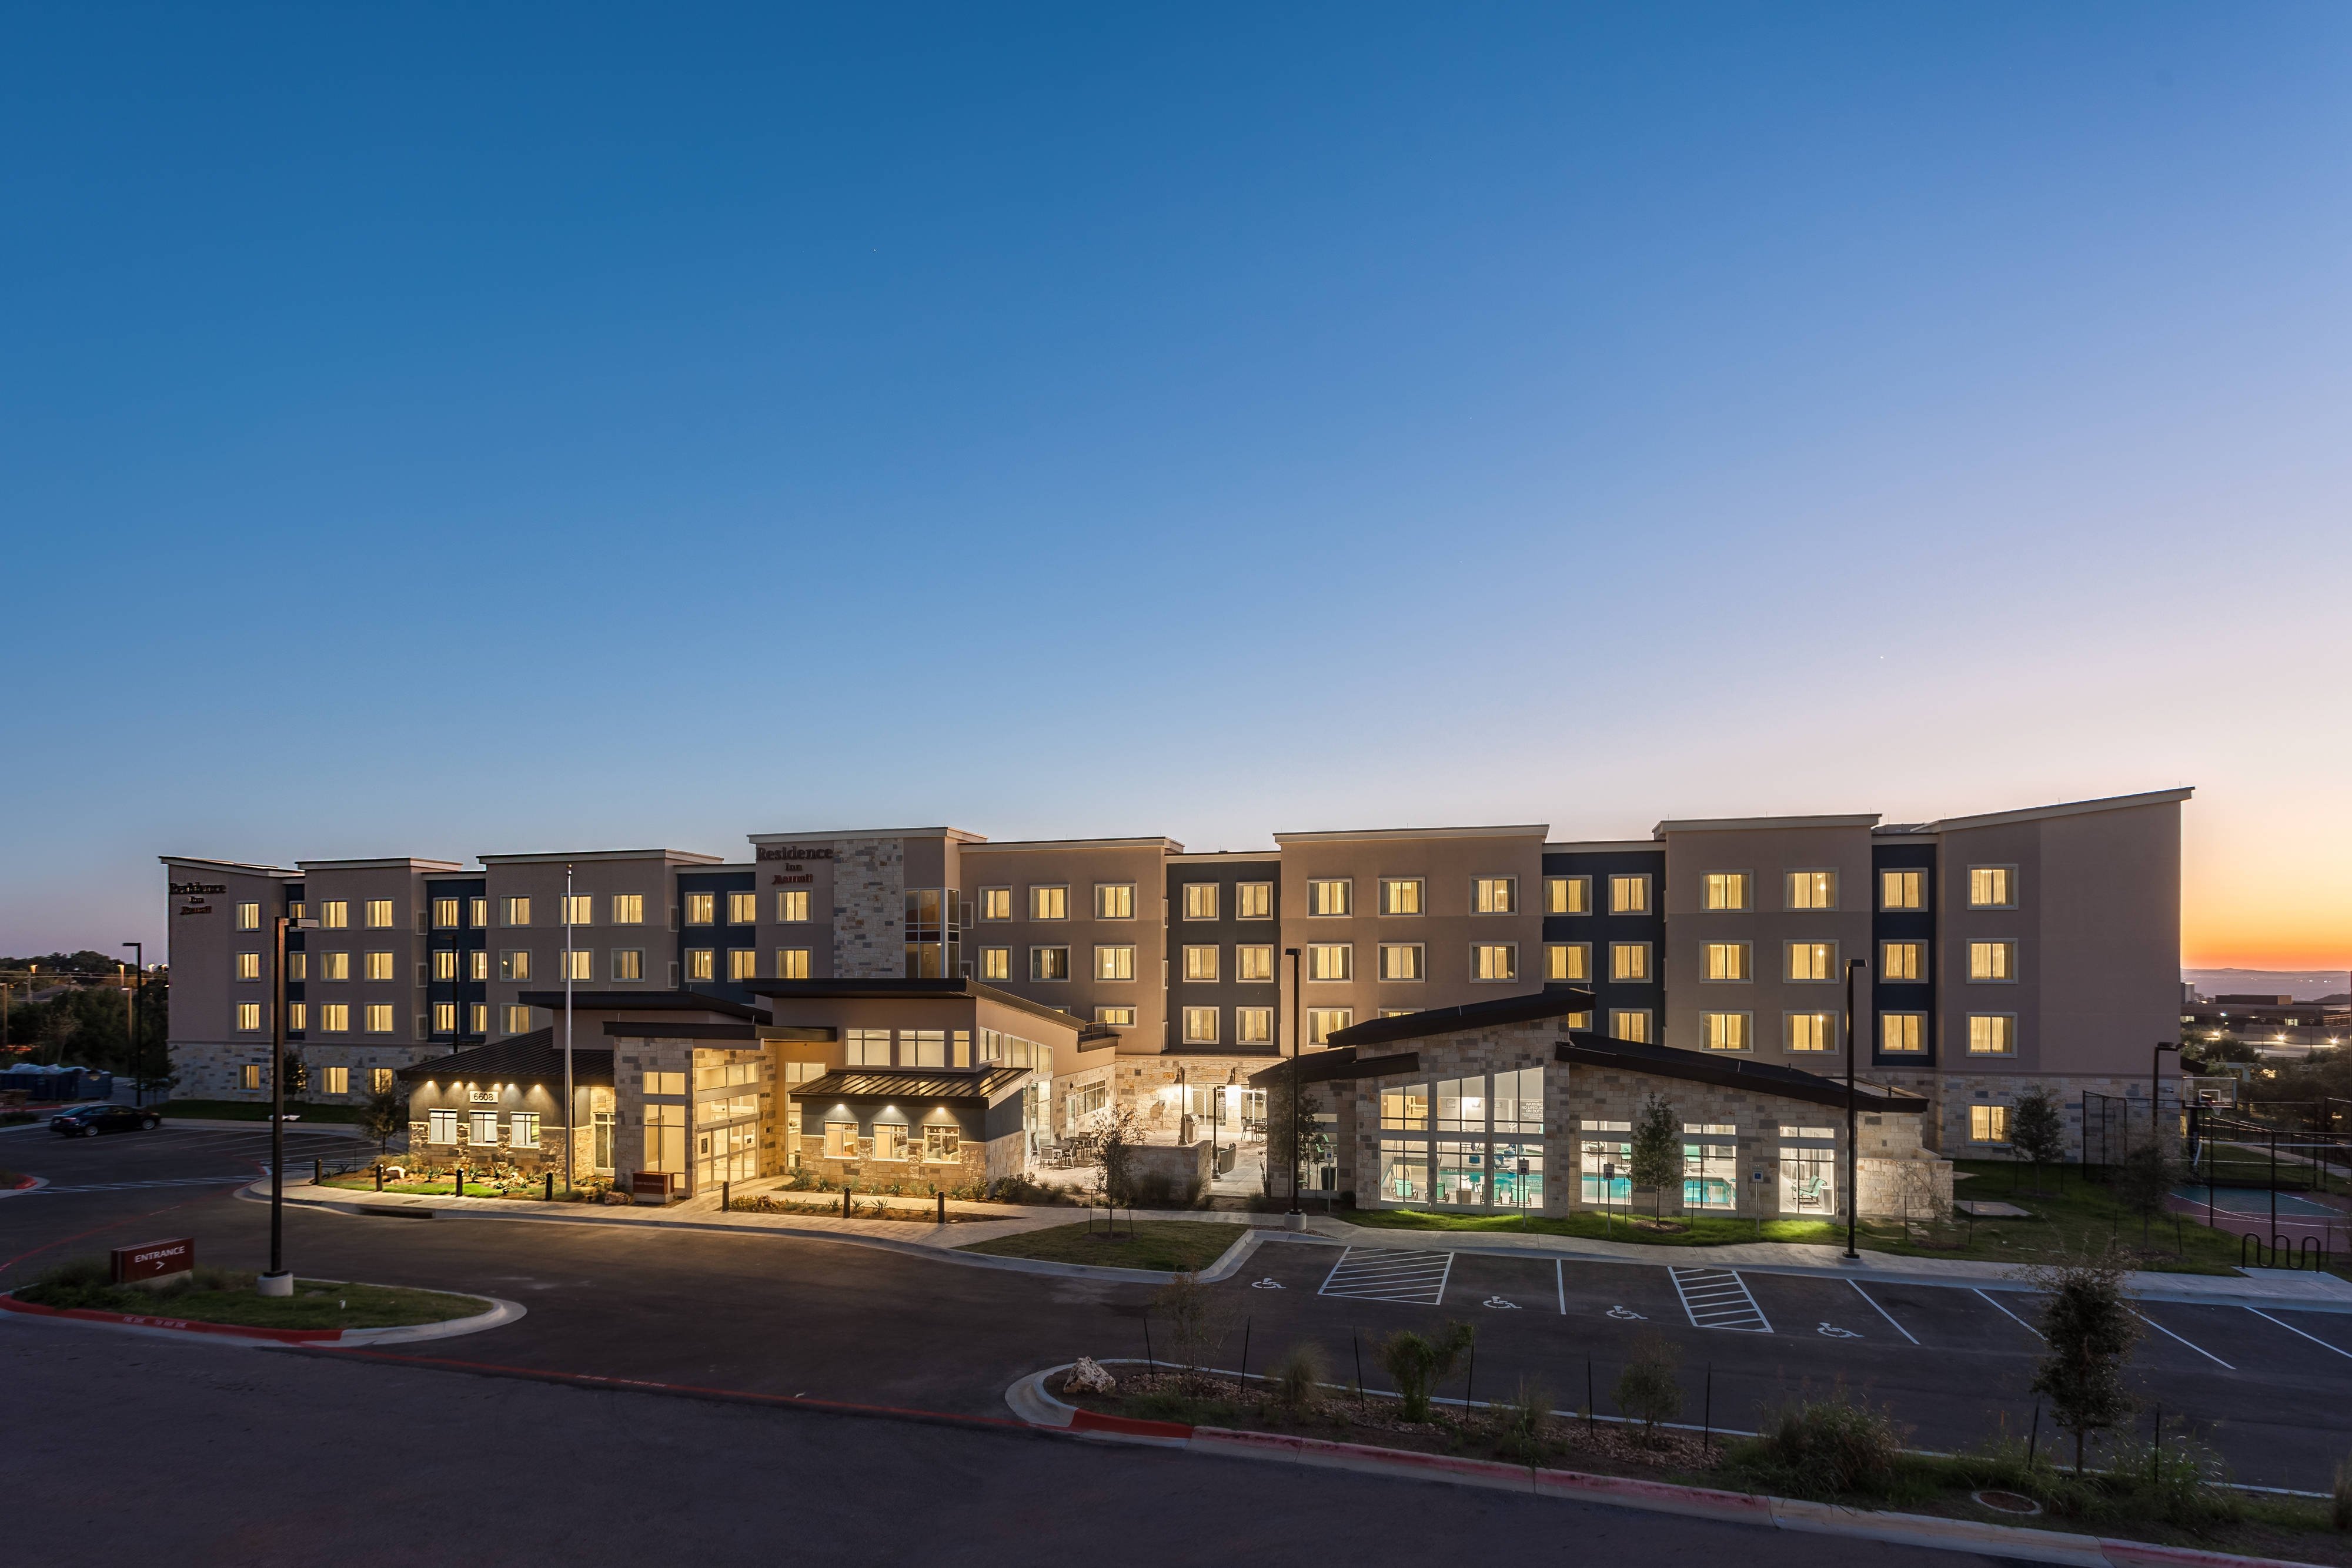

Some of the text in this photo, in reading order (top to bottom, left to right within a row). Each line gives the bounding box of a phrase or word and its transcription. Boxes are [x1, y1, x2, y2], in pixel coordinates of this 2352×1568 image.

[756, 845, 834, 861] Residence
[785, 862, 803, 871] Inn
[134, 1246, 186, 1263] ENTRANCE
